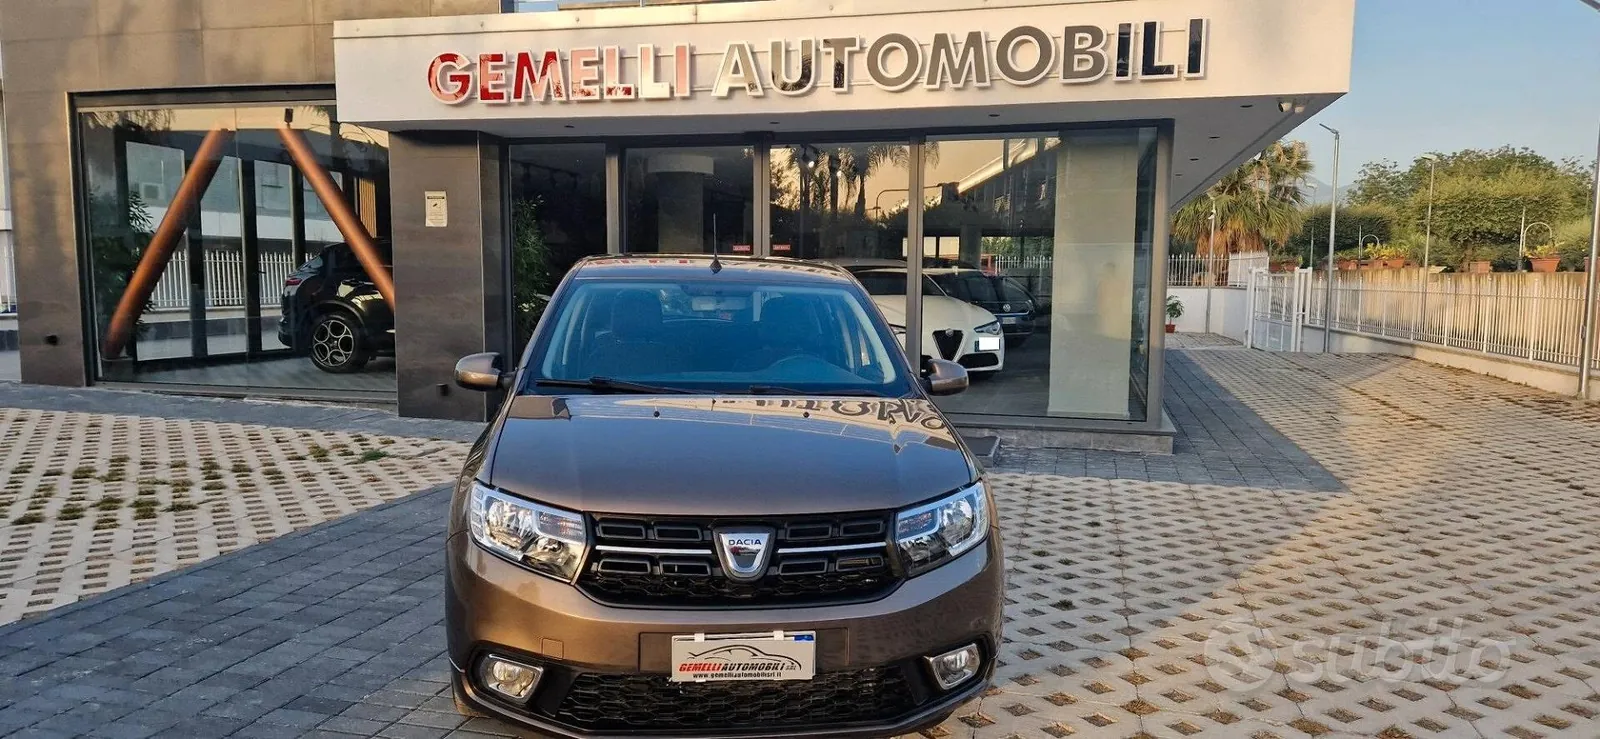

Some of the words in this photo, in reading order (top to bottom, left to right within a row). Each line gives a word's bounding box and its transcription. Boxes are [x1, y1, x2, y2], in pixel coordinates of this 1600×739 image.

[427, 42, 691, 105] GEMELLI
[711, 18, 1209, 98] AUTOMOBILI
[728, 538, 762, 546] DACIA
